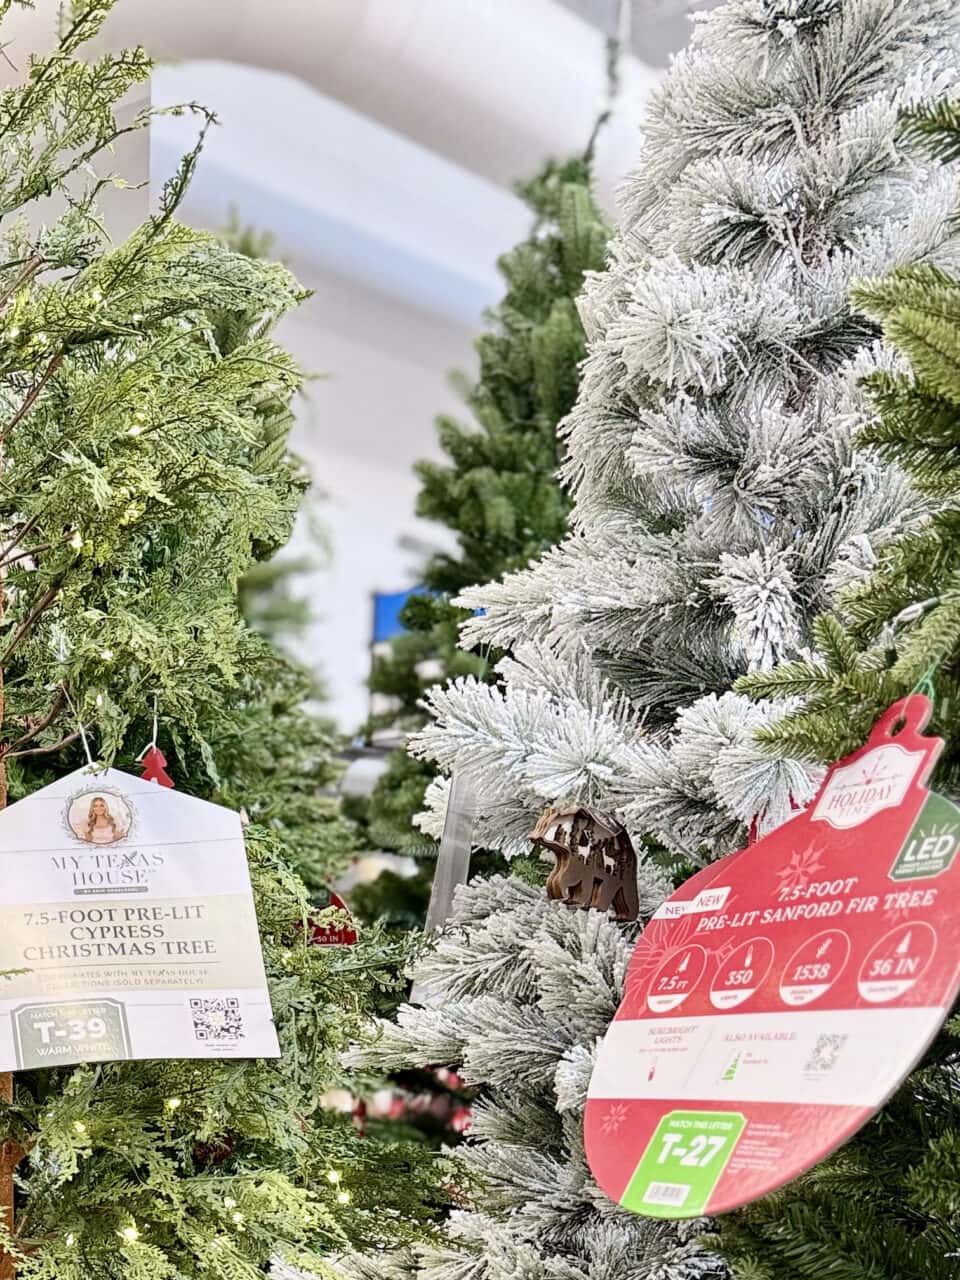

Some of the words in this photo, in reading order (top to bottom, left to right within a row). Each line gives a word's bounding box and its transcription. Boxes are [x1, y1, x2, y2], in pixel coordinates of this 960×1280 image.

[827, 784, 892, 810] HOLIDAY
[903, 834, 955, 862] LED
[50, 855, 81, 871] MY
[90, 850, 166, 870] TEXAS
[72, 869, 149, 887] HOUSE
[695, 894, 723, 908] NEW
[777, 878, 859, 903] 7.5-FOOT
[23, 908, 118, 927] 7.5-FOOT
[124, 904, 206, 922] PRE-LIT
[696, 911, 761, 933] PRE-LIT
[759, 904, 843, 925] SANFORD
[846, 897, 879, 914] FIR
[883, 888, 938, 909] TREE
[69, 924, 165, 941] CYPRESS
[23, 942, 157, 962] CHRISTMAS
[161, 939, 217, 956] TREE
[792, 963, 832, 981] 1538
[869, 959, 892, 977] 36
[894, 956, 920, 975] IN
[657, 976, 678, 991] 7.5
[724, 969, 753, 986] 350
[33, 1017, 107, 1044] T-39
[36, 1045, 72, 1057] WARM
[656, 1132, 727, 1168] T-27
